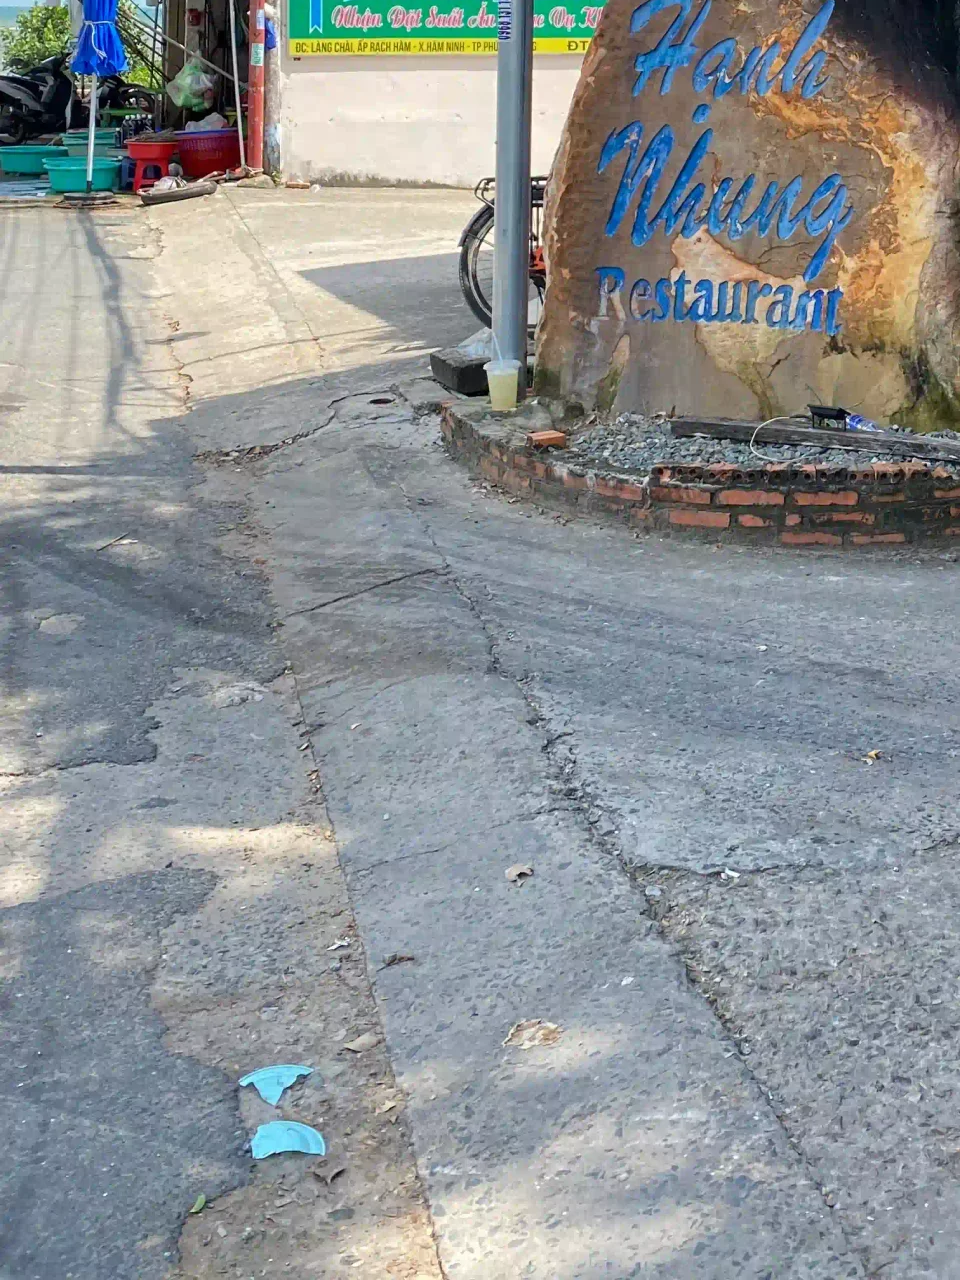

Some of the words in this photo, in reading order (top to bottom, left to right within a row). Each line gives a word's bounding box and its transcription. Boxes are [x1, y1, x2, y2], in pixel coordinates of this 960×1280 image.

[331, 5, 383, 32] Nhận
[387, 5, 422, 32] Đặt
[295, 41, 309, 53] ĐC:
[311, 40, 332, 53] LÀNG
[393, 40, 411, 52] HÀM
[446, 41, 465, 52] NINH
[598, 120, 853, 282] Nhung
[595, 266, 844, 336] Restaurant
